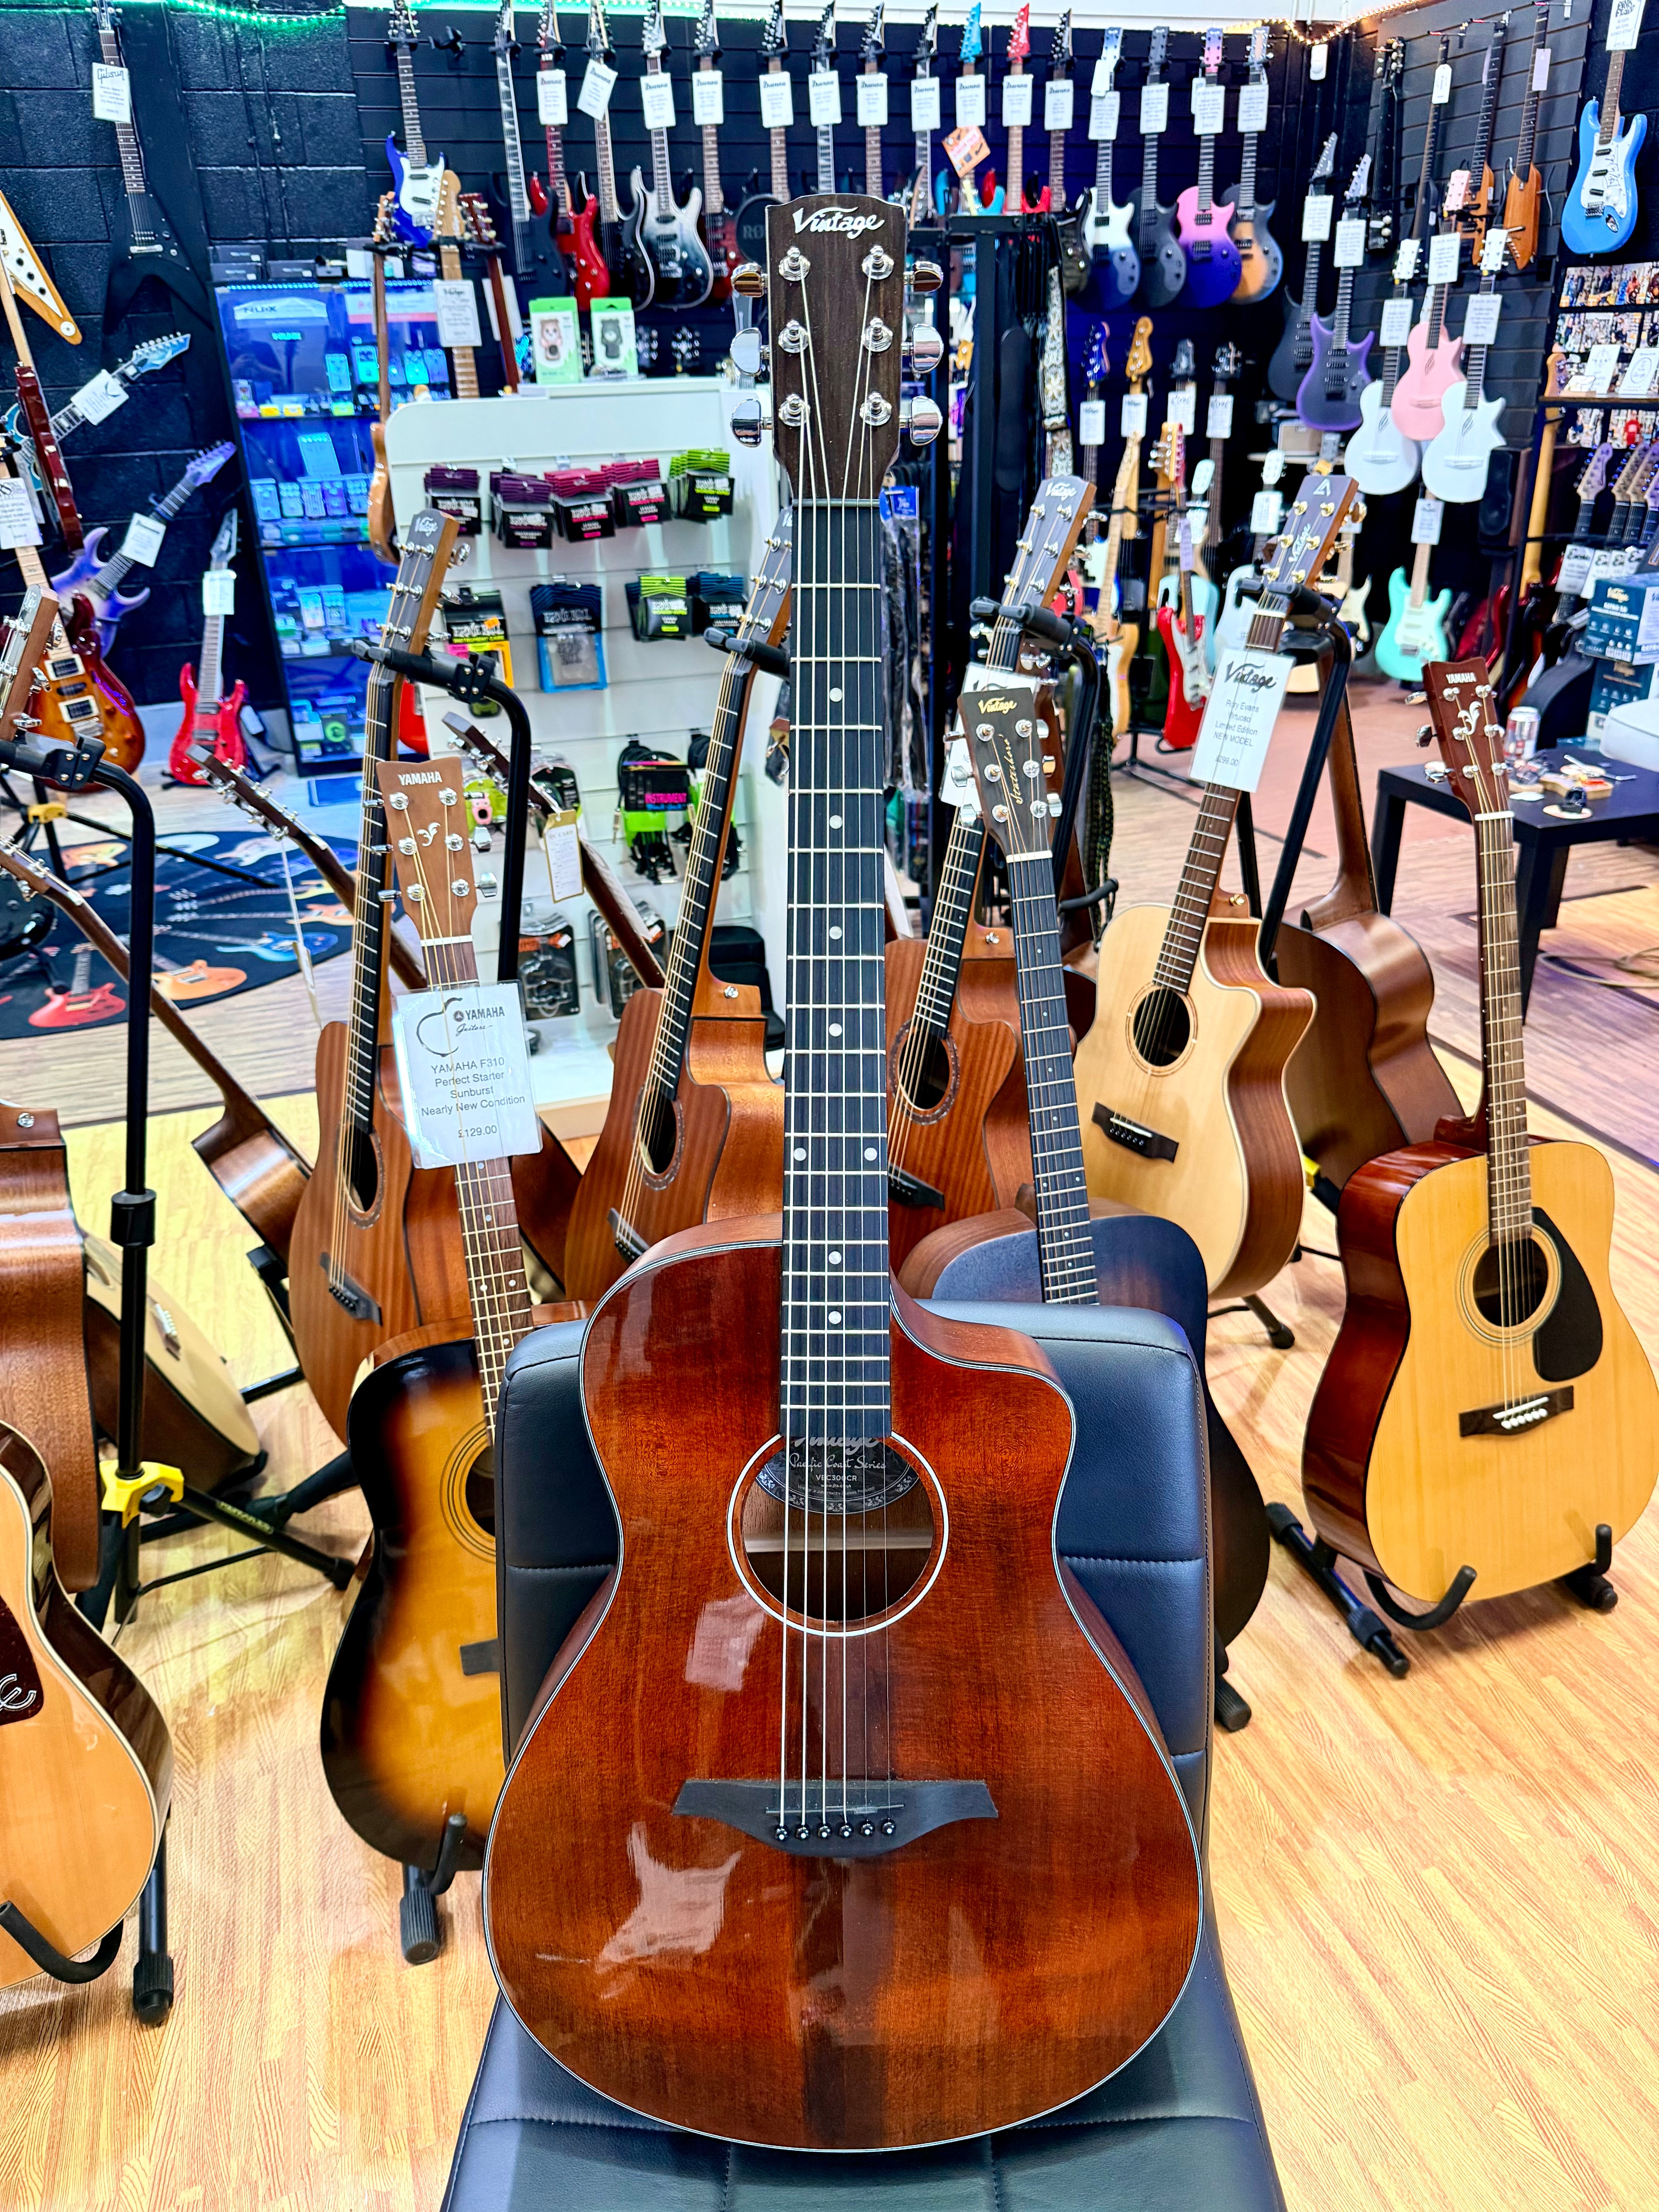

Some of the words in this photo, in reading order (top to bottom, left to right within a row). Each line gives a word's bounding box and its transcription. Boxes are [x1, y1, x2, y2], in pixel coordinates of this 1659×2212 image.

[792, 207, 885, 239] Vintage
[1224, 661, 1277, 694] Vintage
[1446, 672, 1477, 684] YAMAHA
[978, 697, 1017, 714] Vintage
[1240, 702, 1259, 713] Evans
[1237, 724, 1258, 736] Edition
[1230, 735, 1254, 747] MODEL
[398, 771, 443, 786] YAMAHA
[465, 1006, 505, 1020] YAMAHA
[455, 1023, 493, 1037] Guitars
[431, 1061, 477, 1074] YAMAHA
[480, 1057, 505, 1069] F310
[435, 1075, 470, 1087] Perfect
[473, 1071, 505, 1083] Starter
[450, 1086, 494, 1099] Sunburst
[421, 1104, 453, 1116] Nearly
[456, 1101, 477, 1112] New
[480, 1095, 525, 1108] Condition
[458, 1125, 497, 1138] £129.00
[790, 1453, 822, 1472] Pacfic
[826, 1455, 854, 1468] Coat
[854, 1455, 886, 1469] Series
